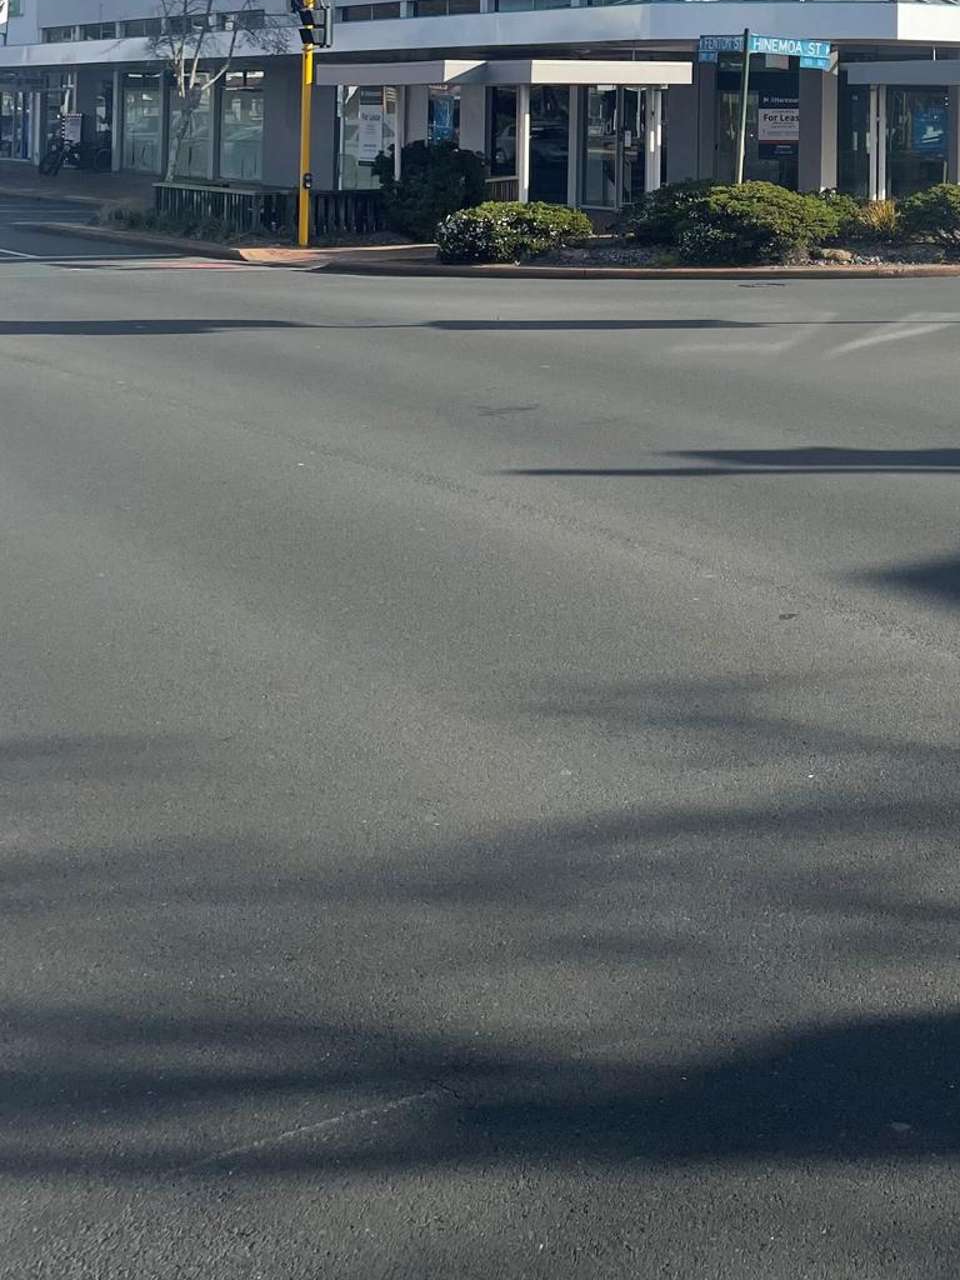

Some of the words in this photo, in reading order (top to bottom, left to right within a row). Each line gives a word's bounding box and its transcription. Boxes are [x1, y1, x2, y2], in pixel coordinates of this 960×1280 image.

[752, 37, 802, 53] HINEMOA
[807, 42, 823, 56] ST
[763, 113, 778, 122] For
[780, 114, 800, 122] Leas
